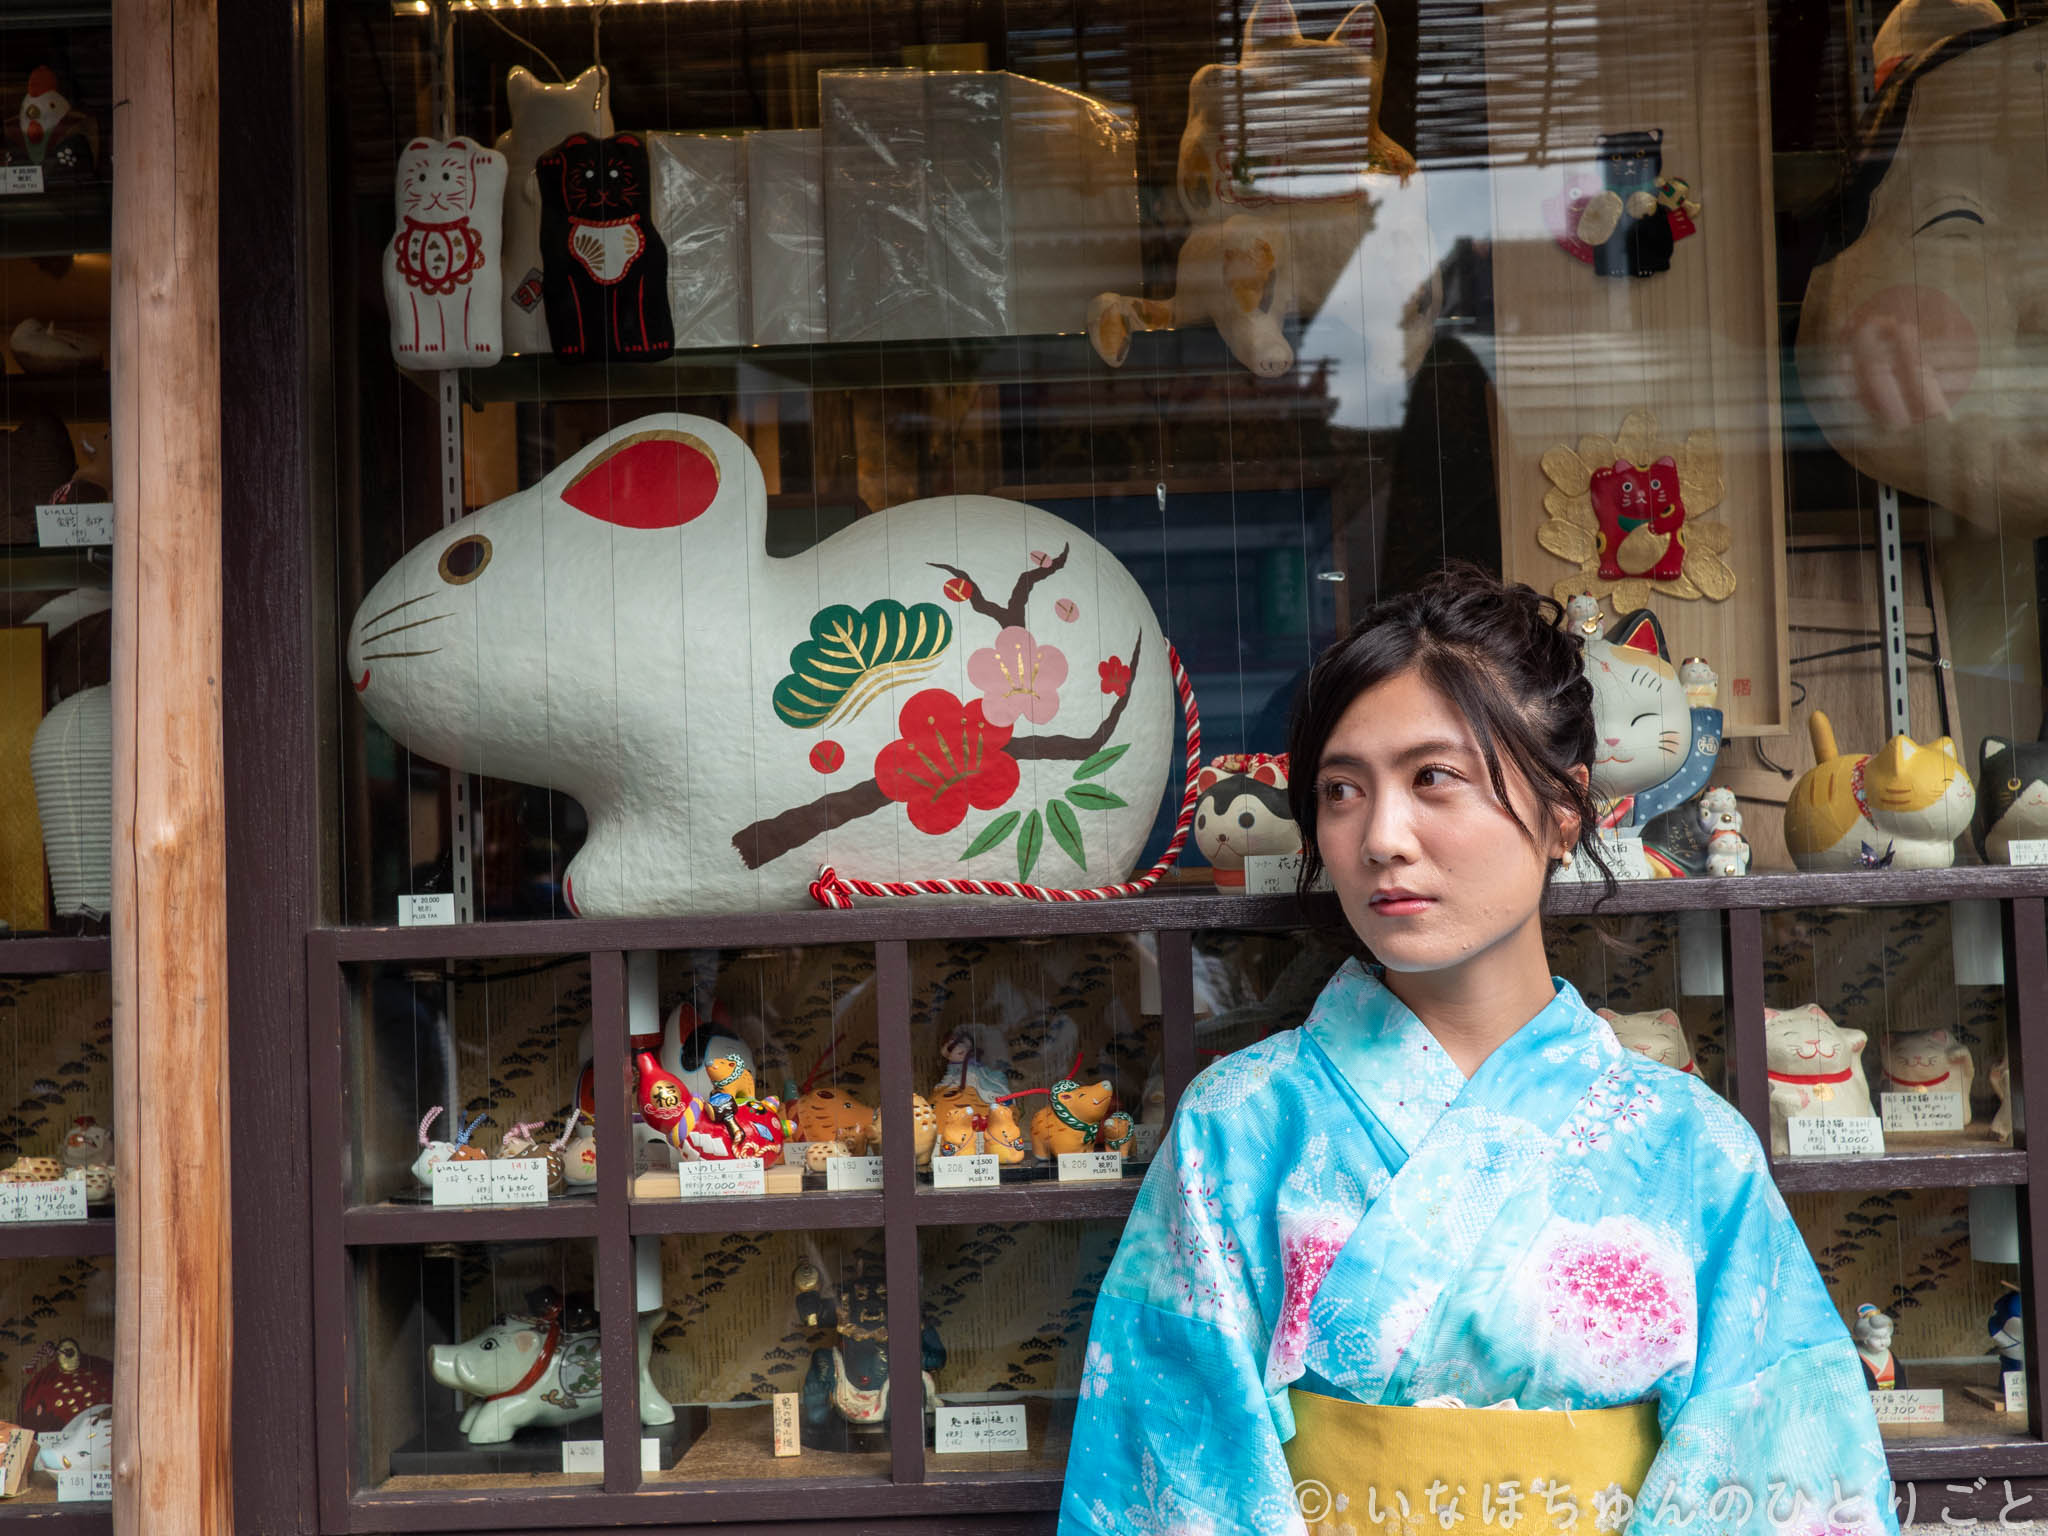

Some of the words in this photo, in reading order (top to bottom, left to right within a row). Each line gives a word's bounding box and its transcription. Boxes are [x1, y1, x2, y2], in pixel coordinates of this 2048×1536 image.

[652, 1084, 679, 1108] 福
[687, 1163, 726, 1174] いのしし
